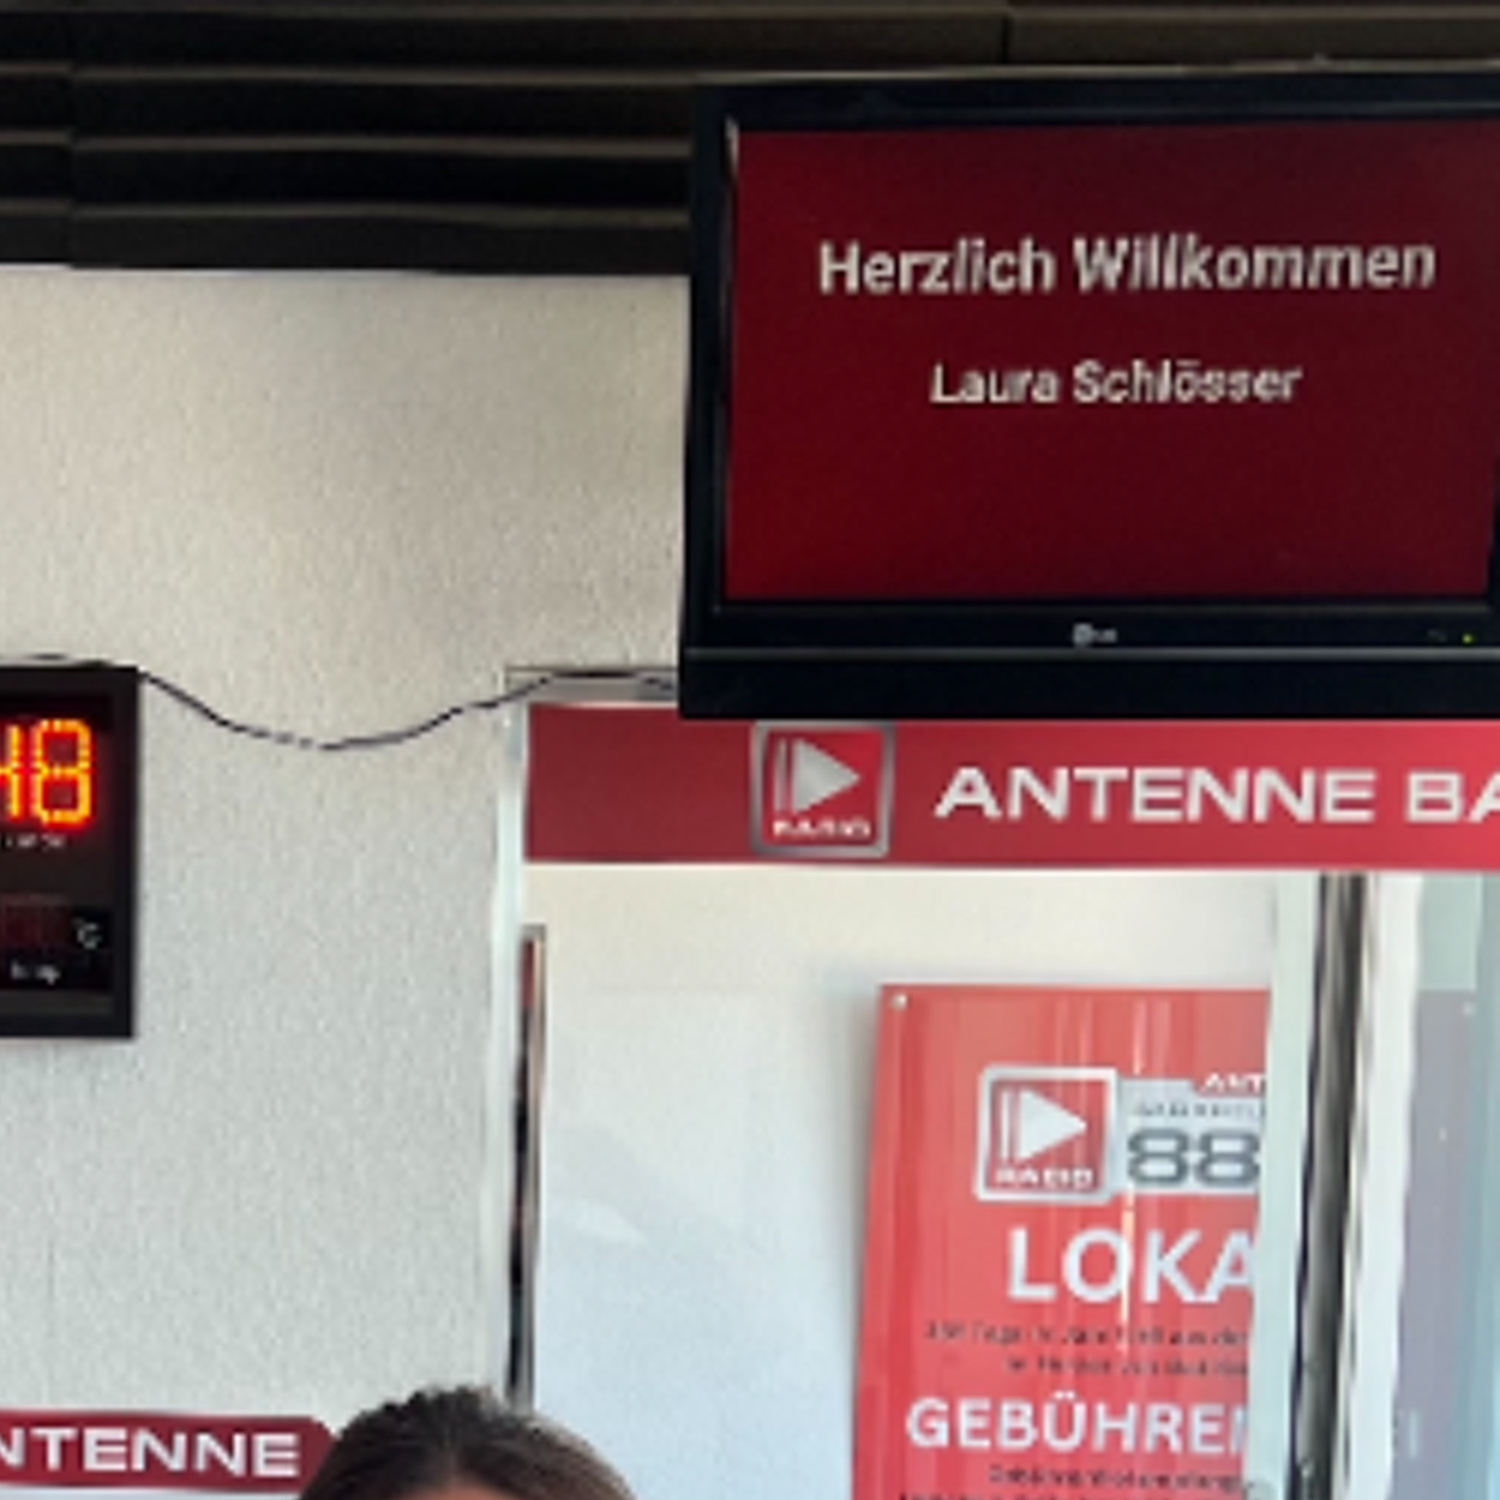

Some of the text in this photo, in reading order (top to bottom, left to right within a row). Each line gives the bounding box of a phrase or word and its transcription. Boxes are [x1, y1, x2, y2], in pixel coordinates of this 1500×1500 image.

[818, 233, 1437, 295] Herzlich Willkommen
[930, 358, 1304, 404] Laura Schlösser
[933, 766, 1378, 824] ANTENNE
[1007, 1226, 1258, 1304] LOKA
